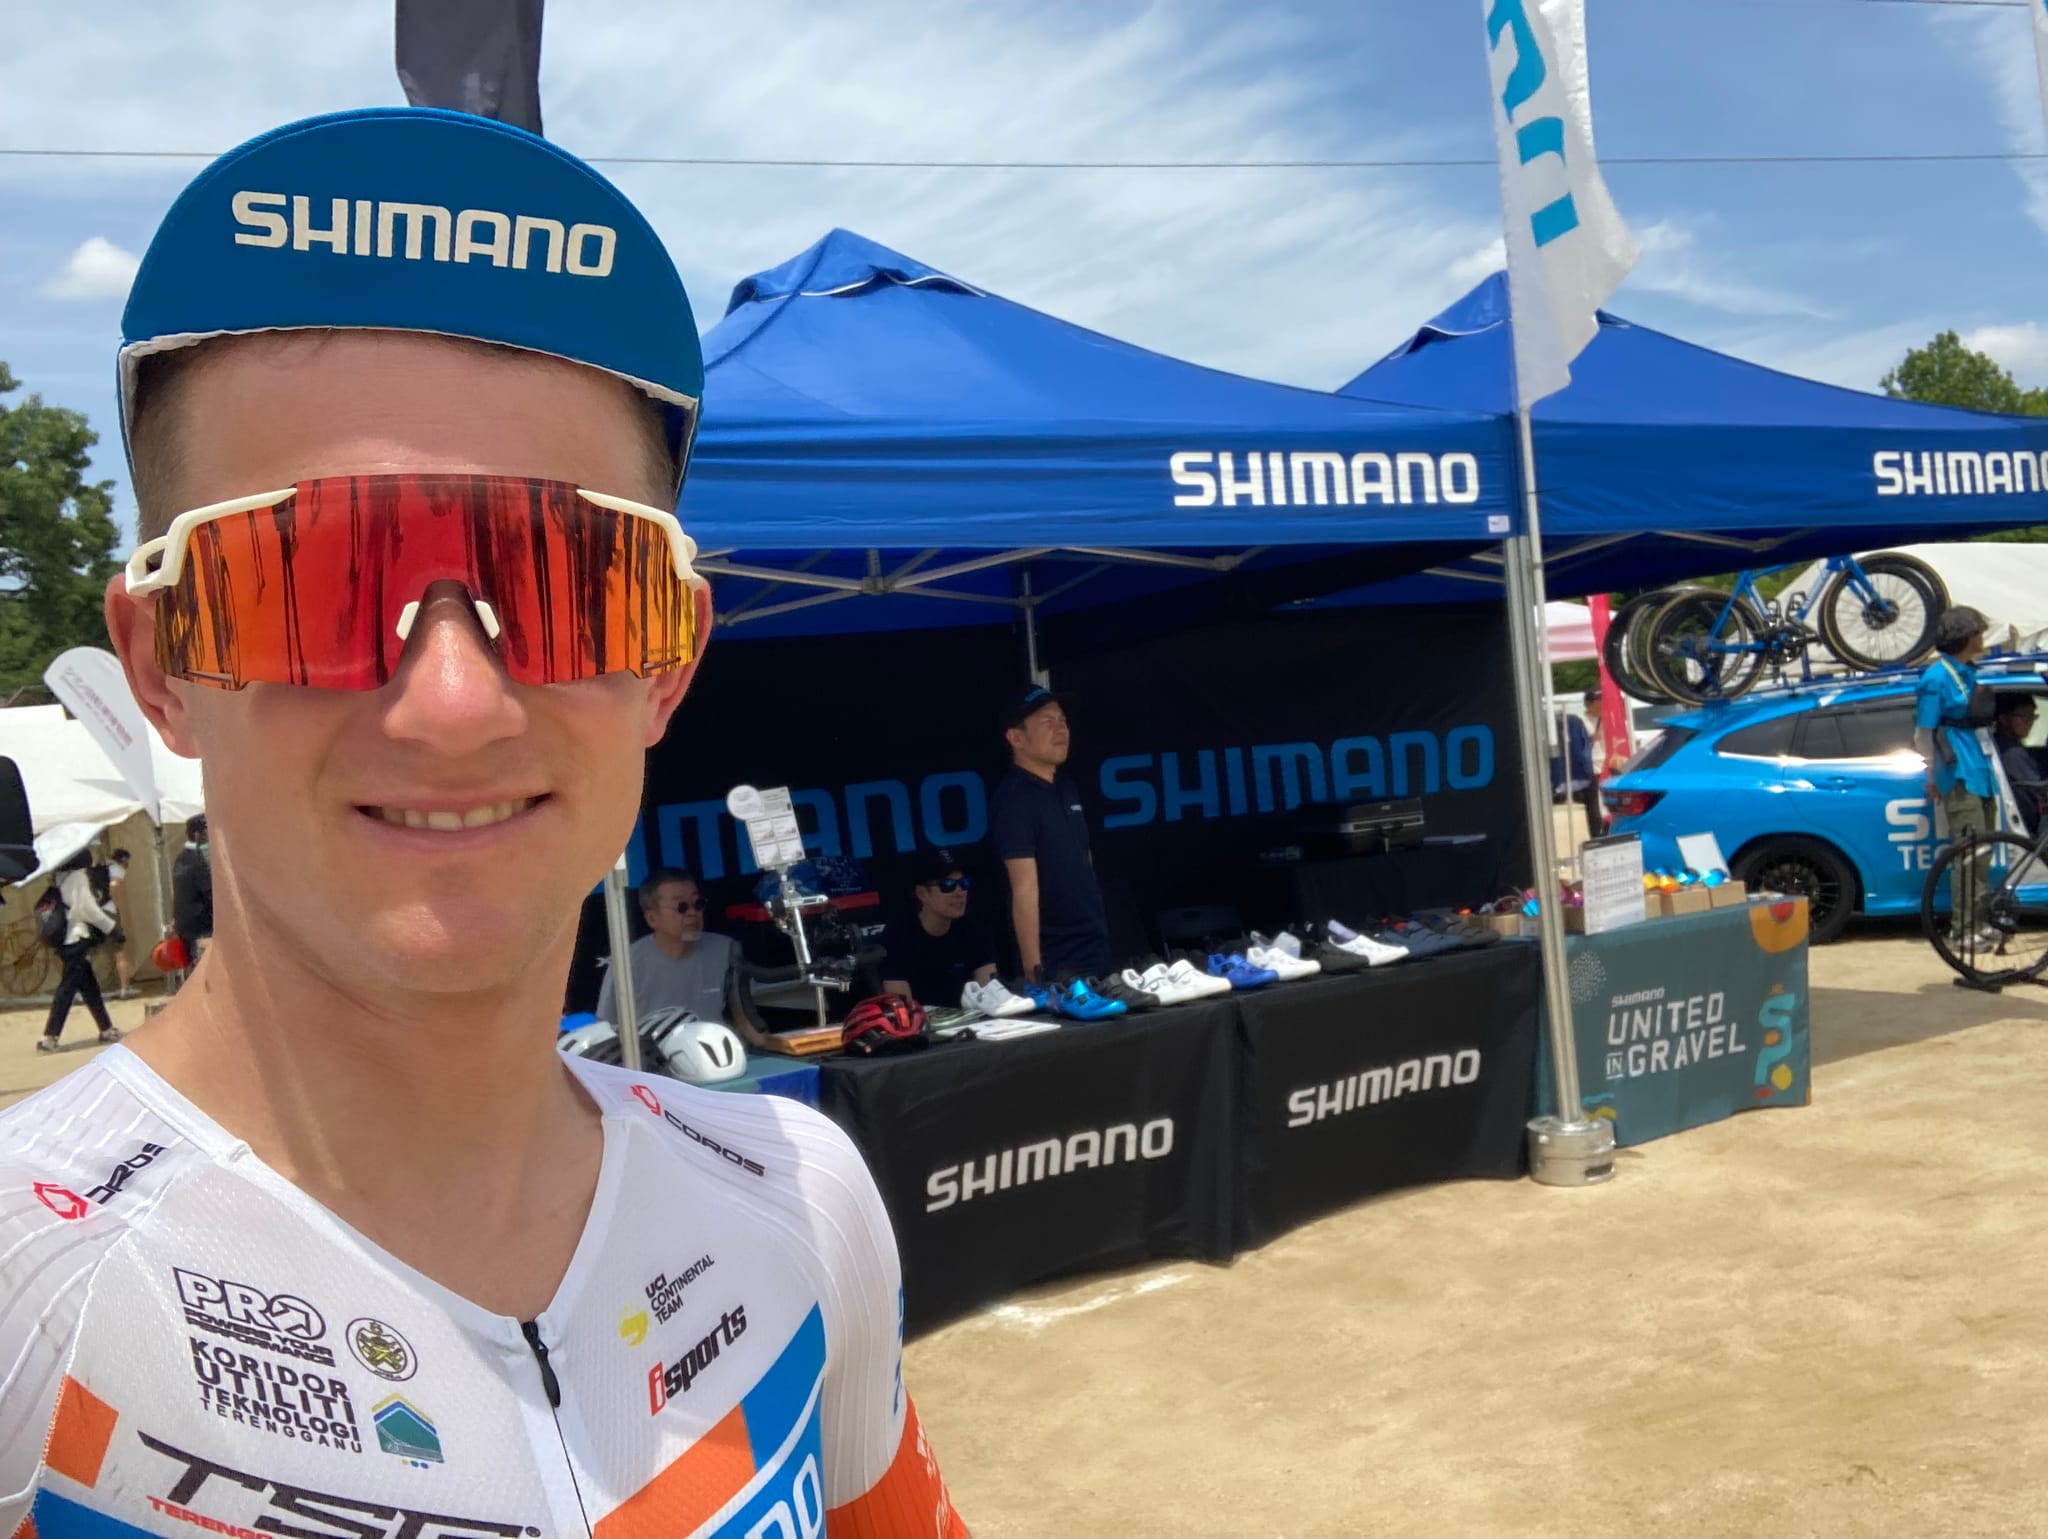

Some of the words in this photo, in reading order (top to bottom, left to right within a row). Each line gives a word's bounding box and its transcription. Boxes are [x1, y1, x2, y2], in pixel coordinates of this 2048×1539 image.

[231, 190, 617, 278] SHIMANO
[1169, 451, 1479, 506] SHIMANO
[1100, 724, 1496, 829] SHIMANO
[1608, 992, 1724, 1045] UNITED
[1611, 987, 1665, 1008] SHIMANO
[1606, 1052, 1623, 1080] IN
[1627, 1022, 1746, 1077] GRAVEL
[1288, 1048, 1481, 1128] SHIMANO
[664, 1109, 765, 1176] COROS
[926, 1117, 1174, 1213] SHIMANO
[645, 1273, 667, 1298] UCI
[651, 1254, 715, 1312] CONTINENTAL
[655, 1295, 684, 1325] TEAM
[189, 1336, 348, 1400] KORIDOR
[194, 1356, 356, 1424] UTILITI
[197, 1380, 360, 1442] TEKNOLOGI
[200, 1398, 362, 1454] TERENGGANU
